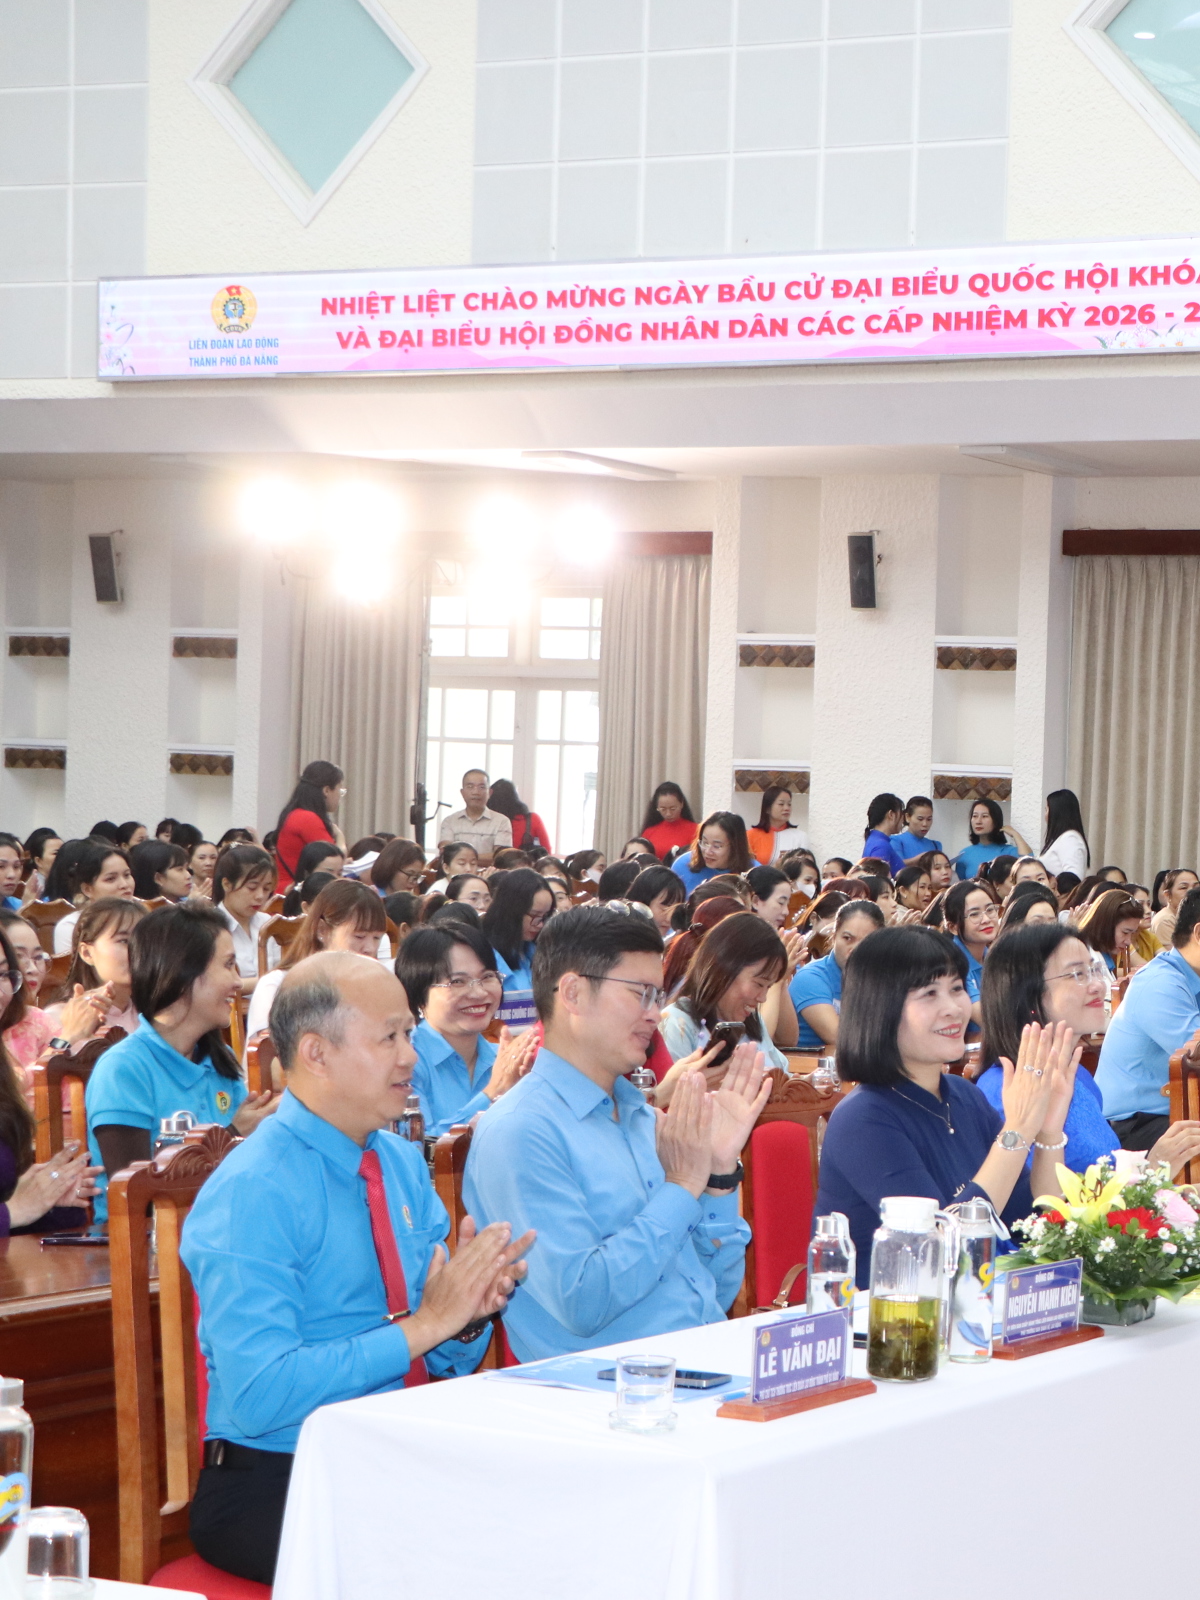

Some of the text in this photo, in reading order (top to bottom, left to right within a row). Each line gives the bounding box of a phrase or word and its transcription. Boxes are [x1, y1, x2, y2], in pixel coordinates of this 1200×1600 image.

[321, 290, 395, 319] NHIỆT
[403, 288, 456, 318] LIỆT
[463, 286, 538, 311] CHÀO
[546, 283, 626, 309] MỪNG
[634, 280, 709, 306] NGÀY
[717, 275, 775, 303] BẦU
[784, 272, 825, 301] CỬ
[831, 277, 882, 304] ĐẠI
[891, 266, 959, 296] BIỂU
[968, 263, 1055, 298] QUỐC
[1064, 262, 1118, 294] HỘI
[188, 336, 279, 350] LIÊN ĐOÀN LAO ĐỘNG
[336, 325, 371, 349] VÀ
[378, 329, 423, 353] ĐẠI
[432, 319, 490, 347] BIỂU
[499, 320, 545, 350] HỘI
[553, 316, 632, 344] ĐỒNG
[641, 315, 719, 341] NHÂN
[728, 313, 788, 338] DÂN
[797, 310, 855, 337] CÁC
[864, 305, 923, 334] CẤP
[932, 304, 1027, 336] NHIỆM
[1037, 301, 1076, 328] KỲ
[1084, 303, 1156, 326] 2026
[189, 354, 217, 367] THÀNH
[220, 353, 237, 366] PHỐ
[1008, 1281, 1078, 1319] NGUYỄN MẠNH KIÊN
[759, 1336, 841, 1379] LÊ VĂN ĐẠI
